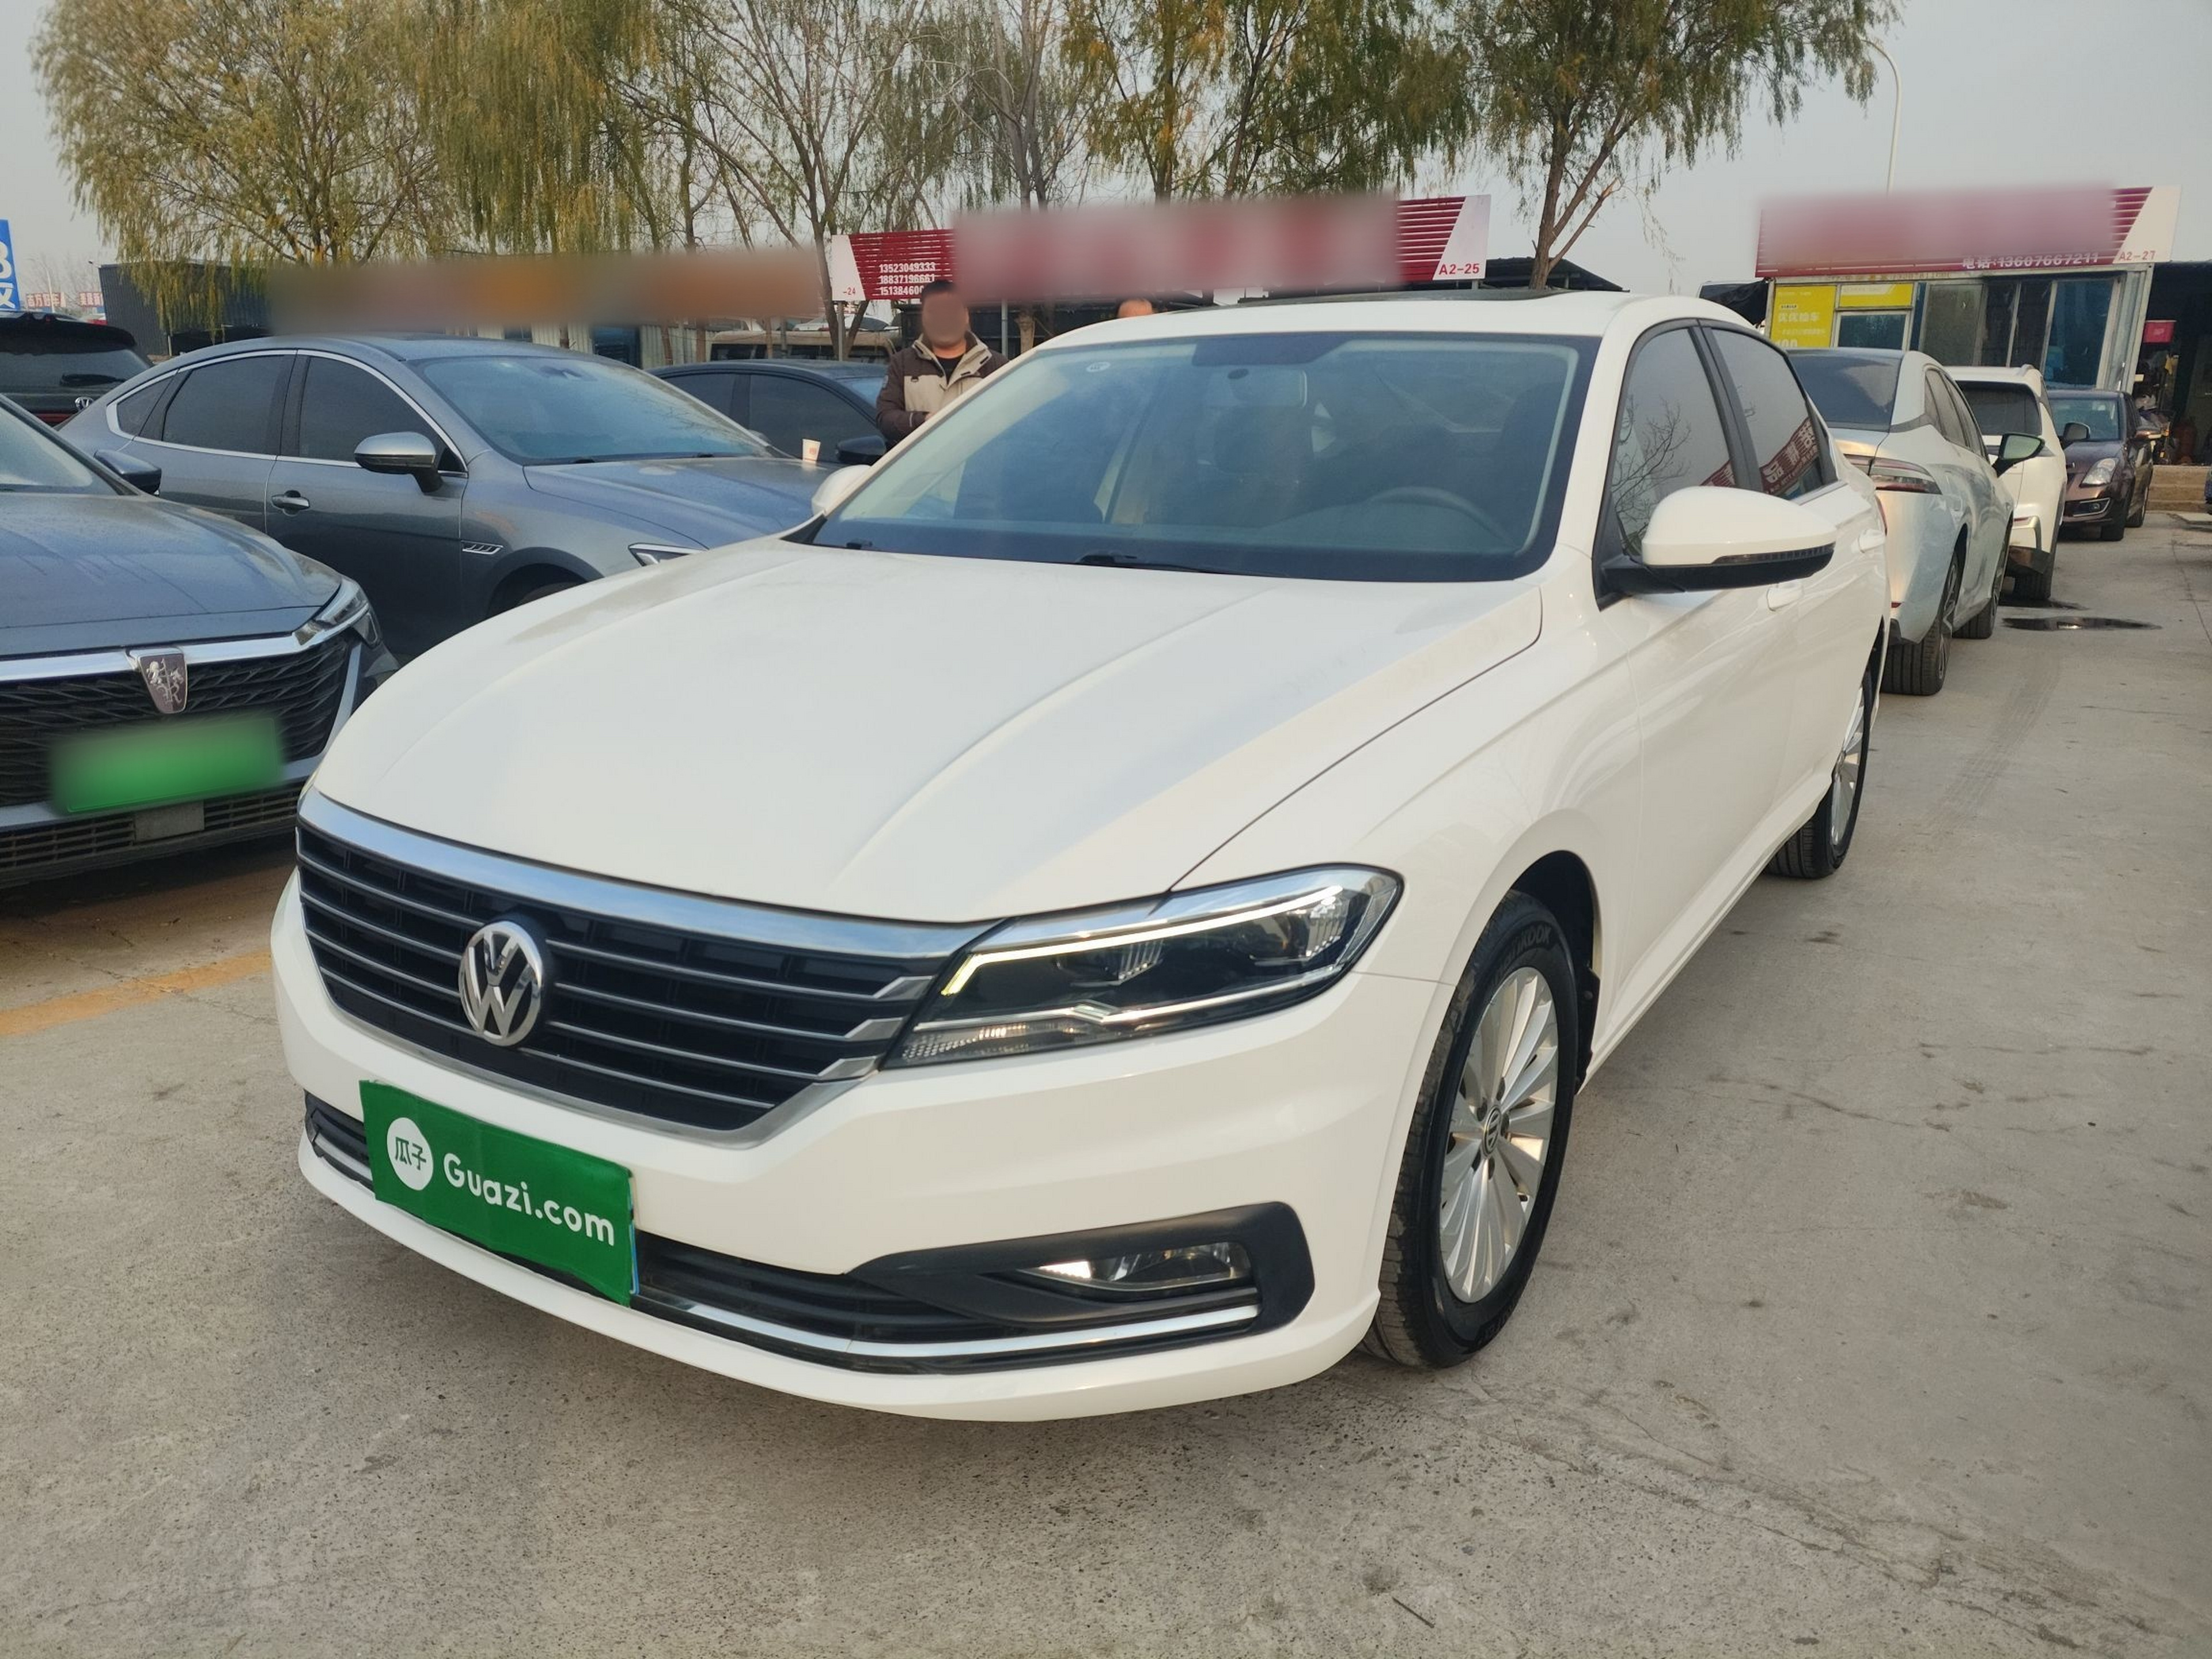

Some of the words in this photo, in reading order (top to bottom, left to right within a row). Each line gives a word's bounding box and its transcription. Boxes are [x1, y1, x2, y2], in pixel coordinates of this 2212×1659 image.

[2119, 250, 2156, 261] A2-27
[1438, 263, 1480, 275] A2-25
[395, 1136, 427, 1171] 瓜子
[444, 1153, 615, 1247] Guazi.com
